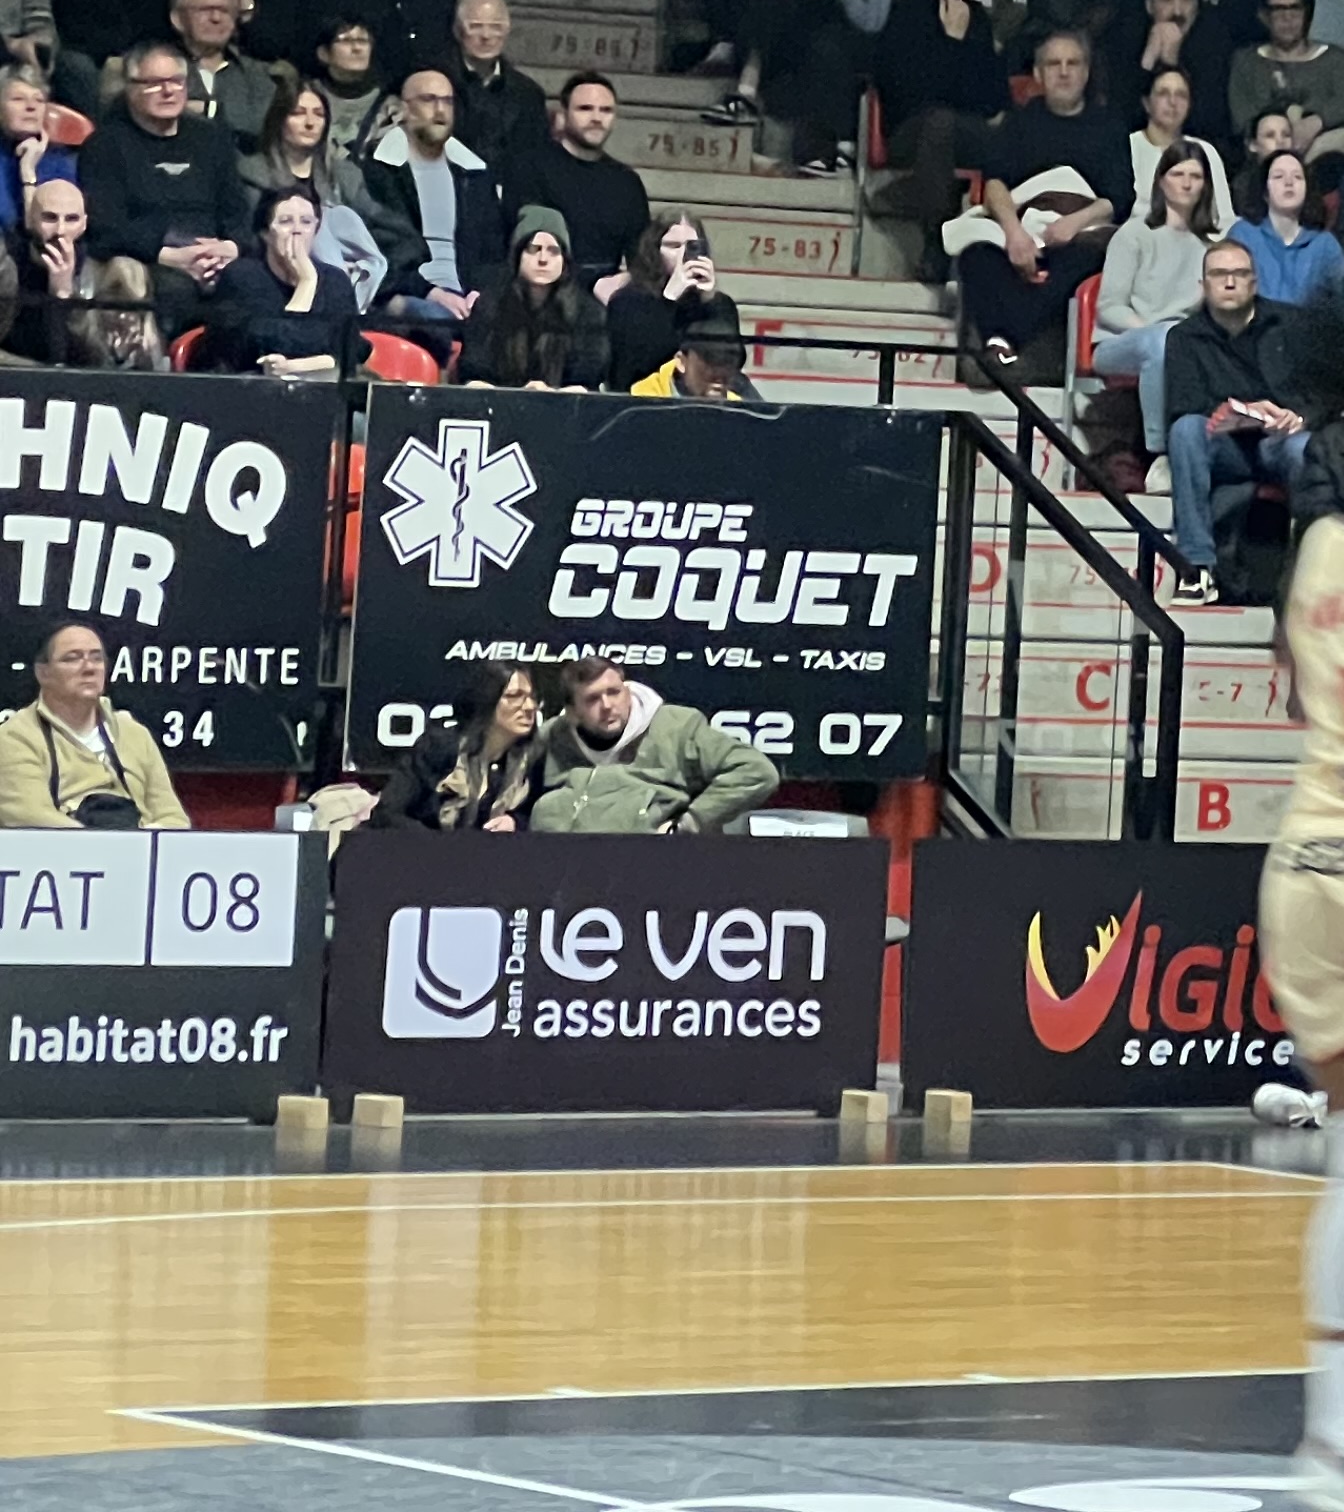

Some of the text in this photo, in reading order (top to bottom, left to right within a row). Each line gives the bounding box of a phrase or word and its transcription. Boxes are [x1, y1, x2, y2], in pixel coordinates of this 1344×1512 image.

[0, 397, 287, 549] HNIQ
[569, 498, 754, 544] GROUPE
[2, 514, 176, 627] TIR
[547, 543, 919, 632] COQUET
[110, 646, 300, 685] ARPENTE
[445, 640, 666, 665] AMBULANCES
[704, 647, 763, 668] VSL
[799, 650, 886, 671] TAXIS
[1075, 664, 1112, 711] C
[162, 711, 215, 747] 34
[818, 713, 904, 757] 07
[1196, 784, 1232, 831] B
[181, 871, 261, 933] 08
[646, 906, 827, 983] ven
[501, 907, 530, 1037] Jean Denis
[9, 1014, 289, 1064] habitat08.fr
[533, 998, 822, 1040] assurances
